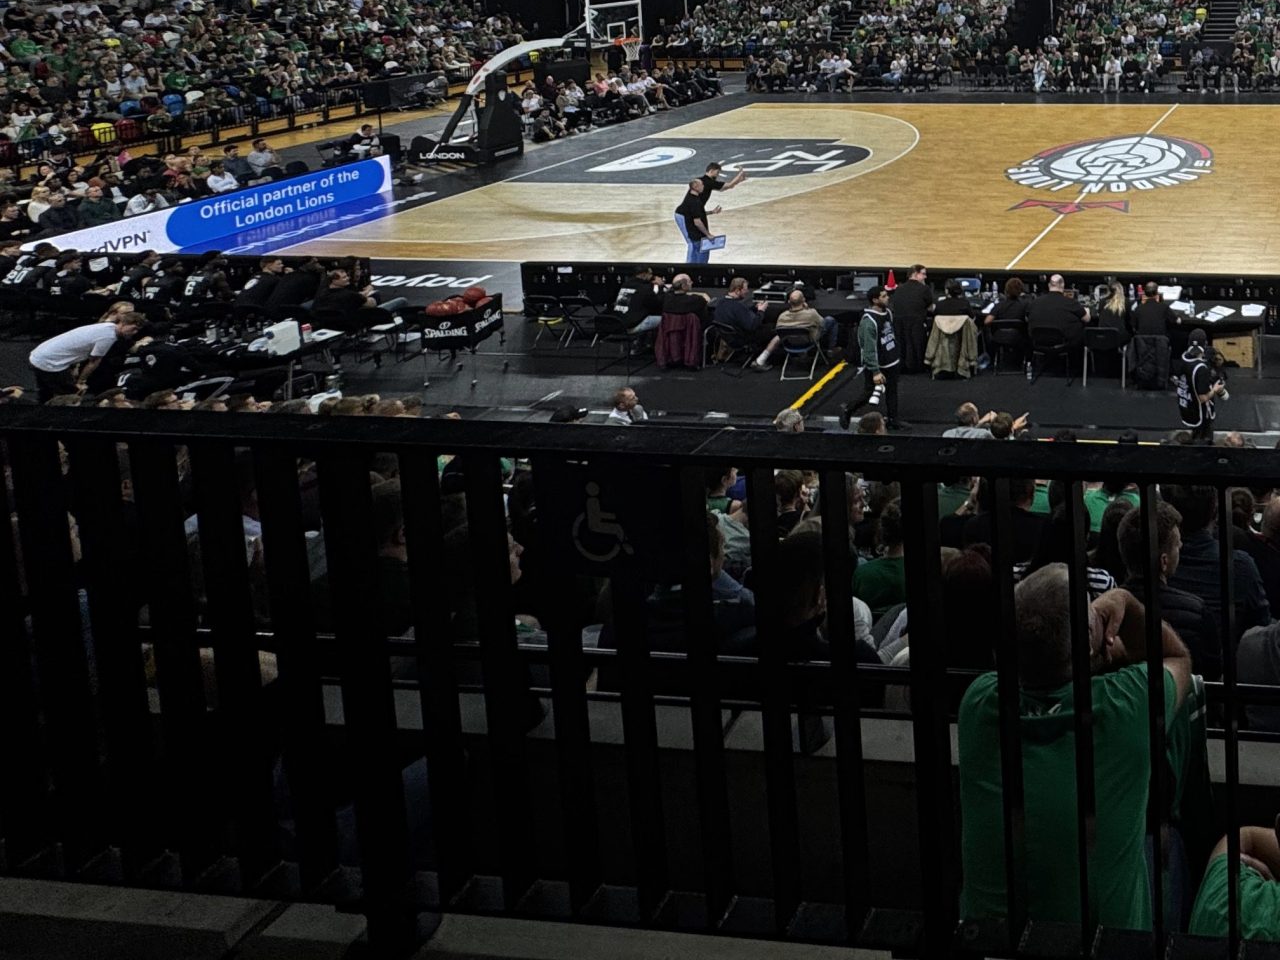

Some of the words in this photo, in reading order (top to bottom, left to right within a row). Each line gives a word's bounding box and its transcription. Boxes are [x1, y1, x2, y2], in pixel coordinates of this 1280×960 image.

[419, 152, 465, 160] LONDON
[1006, 166, 1074, 192] LIONS
[1082, 167, 1213, 193] LONDON
[200, 192, 259, 219] Official
[262, 178, 317, 203] partner
[320, 172, 334, 188] of
[337, 169, 360, 184] the
[235, 203, 293, 228] London
[296, 191, 335, 211] Lions
[424, 326, 468, 339] SPALDING
